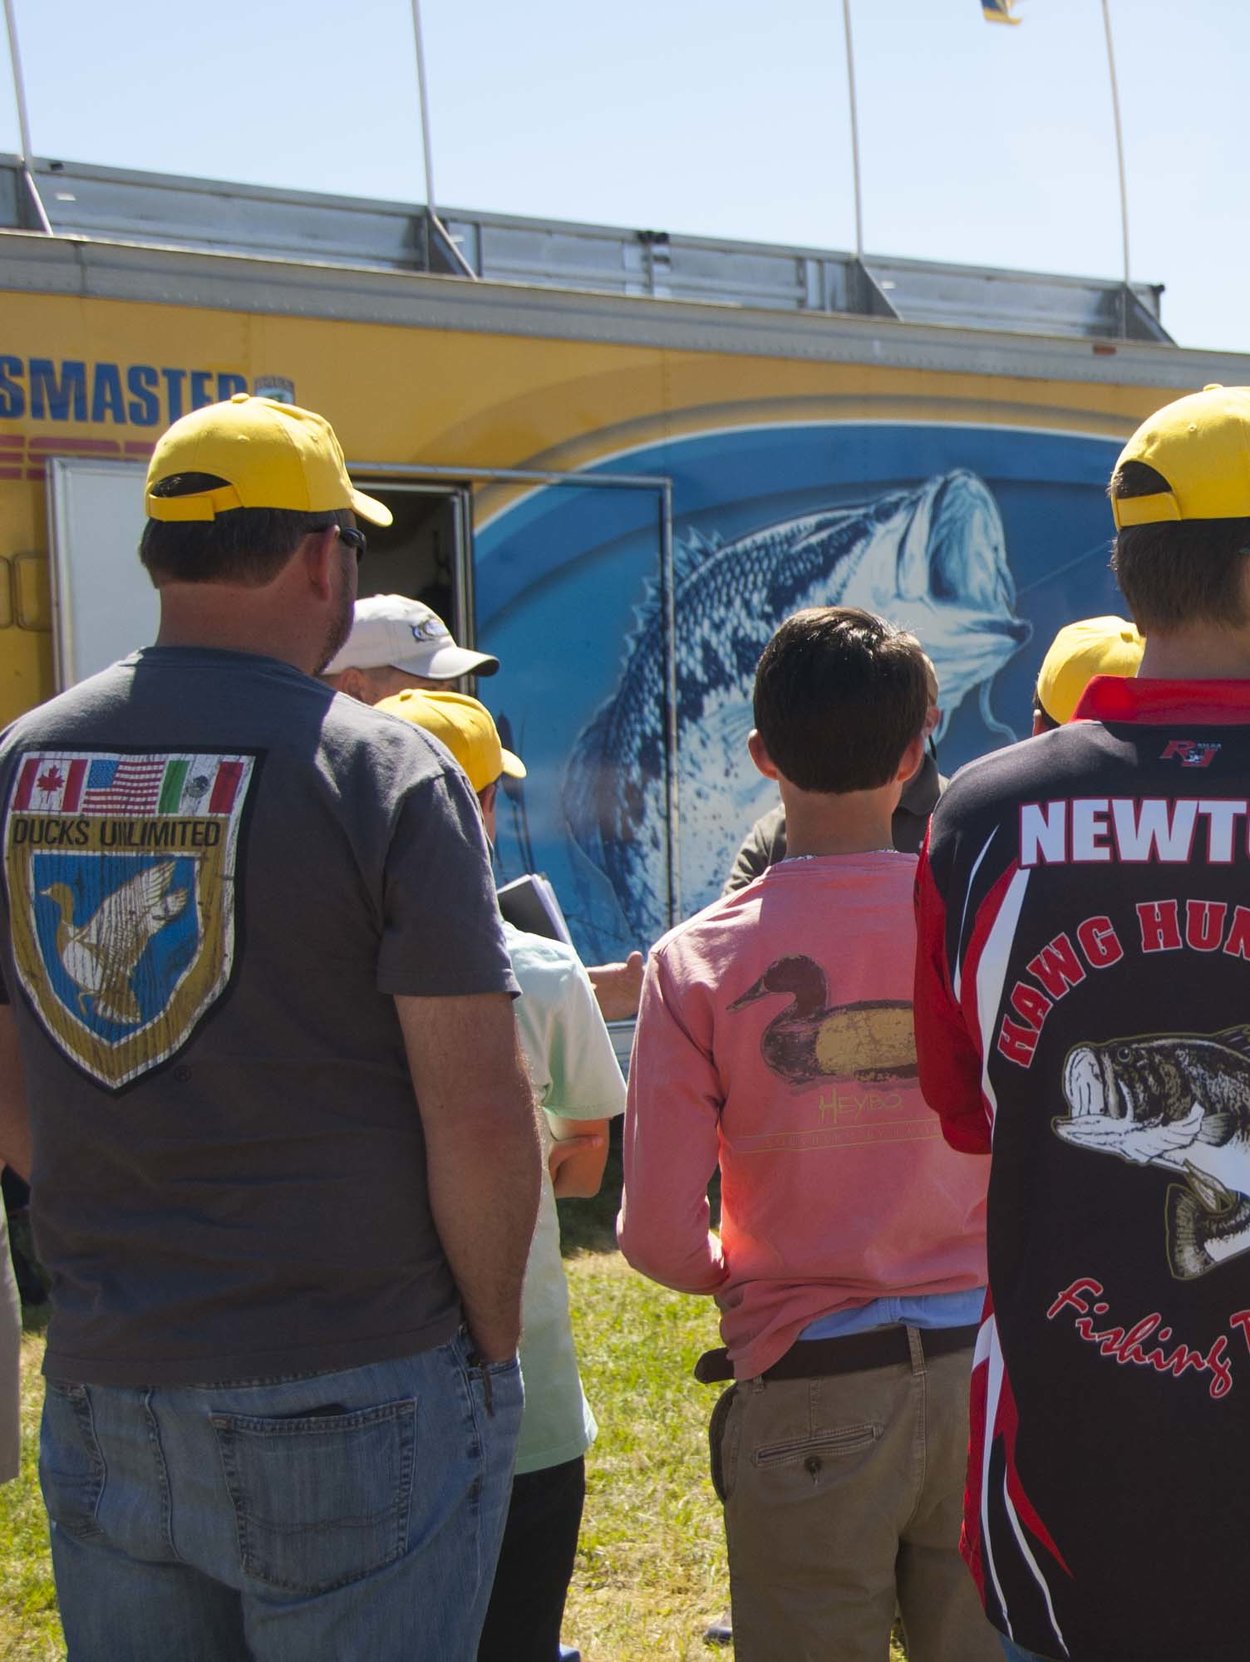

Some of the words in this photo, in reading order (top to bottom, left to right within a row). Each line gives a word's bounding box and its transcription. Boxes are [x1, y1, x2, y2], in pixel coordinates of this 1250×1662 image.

[13, 818, 90, 846] DUCKS
[100, 820, 221, 847] UNLIMITED
[997, 915, 1124, 1069] HAWG
[818, 1086, 905, 1124] HEYBO
[1046, 1276, 1236, 1400] Fishing
